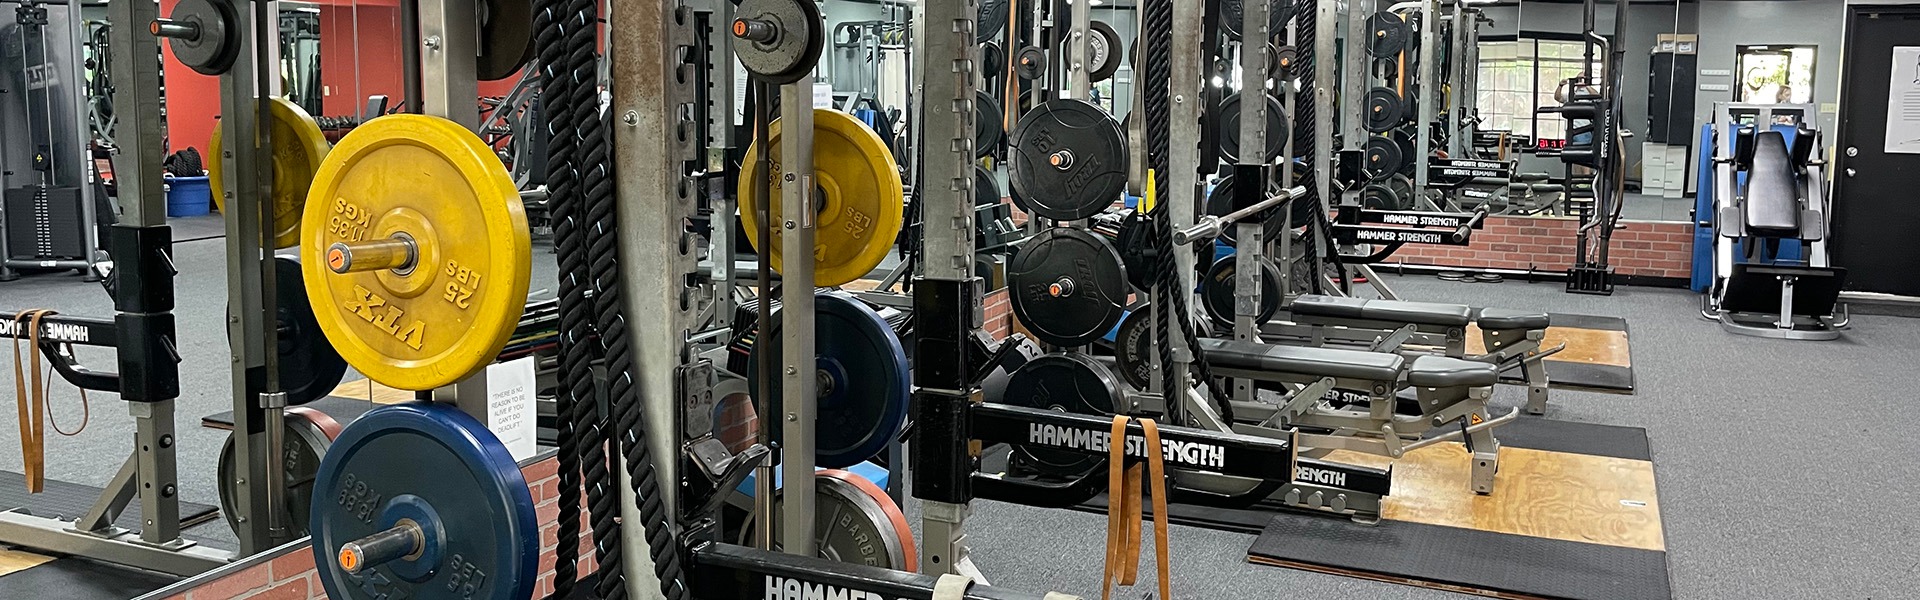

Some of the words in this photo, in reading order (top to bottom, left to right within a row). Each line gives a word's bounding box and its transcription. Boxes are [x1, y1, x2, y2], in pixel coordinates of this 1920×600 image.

[335, 197, 373, 228] KGS
[846, 206, 872, 228] LBS
[1383, 214, 1418, 225] HAMMER
[1420, 216, 1459, 227] STRENGTH
[844, 220, 864, 240] 25
[1357, 229, 1396, 241] HAMMER
[1398, 231, 1441, 243] STRENGTH
[445, 259, 482, 290] LBS
[444, 281, 473, 309] 25
[344, 284, 426, 350] VTX
[492, 399, 511, 408] REASON
[513, 403, 524, 411] YOU
[1125, 434, 1224, 468] STENGTH
